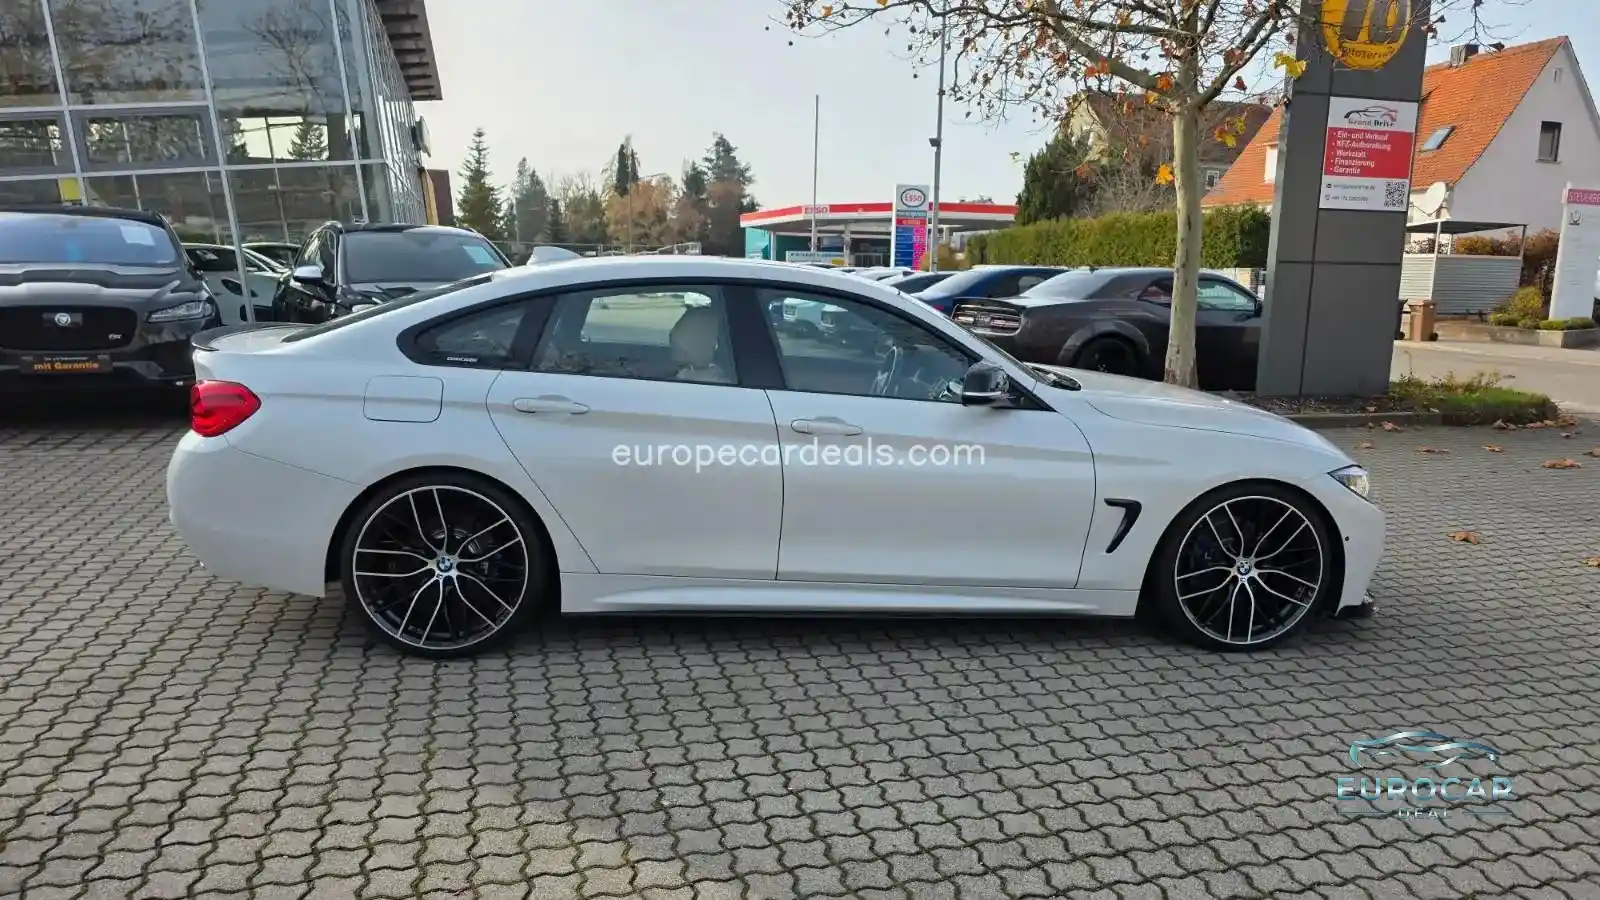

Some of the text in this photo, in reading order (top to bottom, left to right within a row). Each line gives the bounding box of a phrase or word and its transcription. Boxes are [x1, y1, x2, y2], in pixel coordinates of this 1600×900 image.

[1351, 132, 1363, 140] und
[1365, 133, 1389, 141] Verkauf
[1336, 150, 1367, 158] Werkstatt
[1334, 158, 1375, 168] Finanzierung
[1333, 166, 1361, 174] Garantie
[33, 361, 99, 371] mit Garantie
